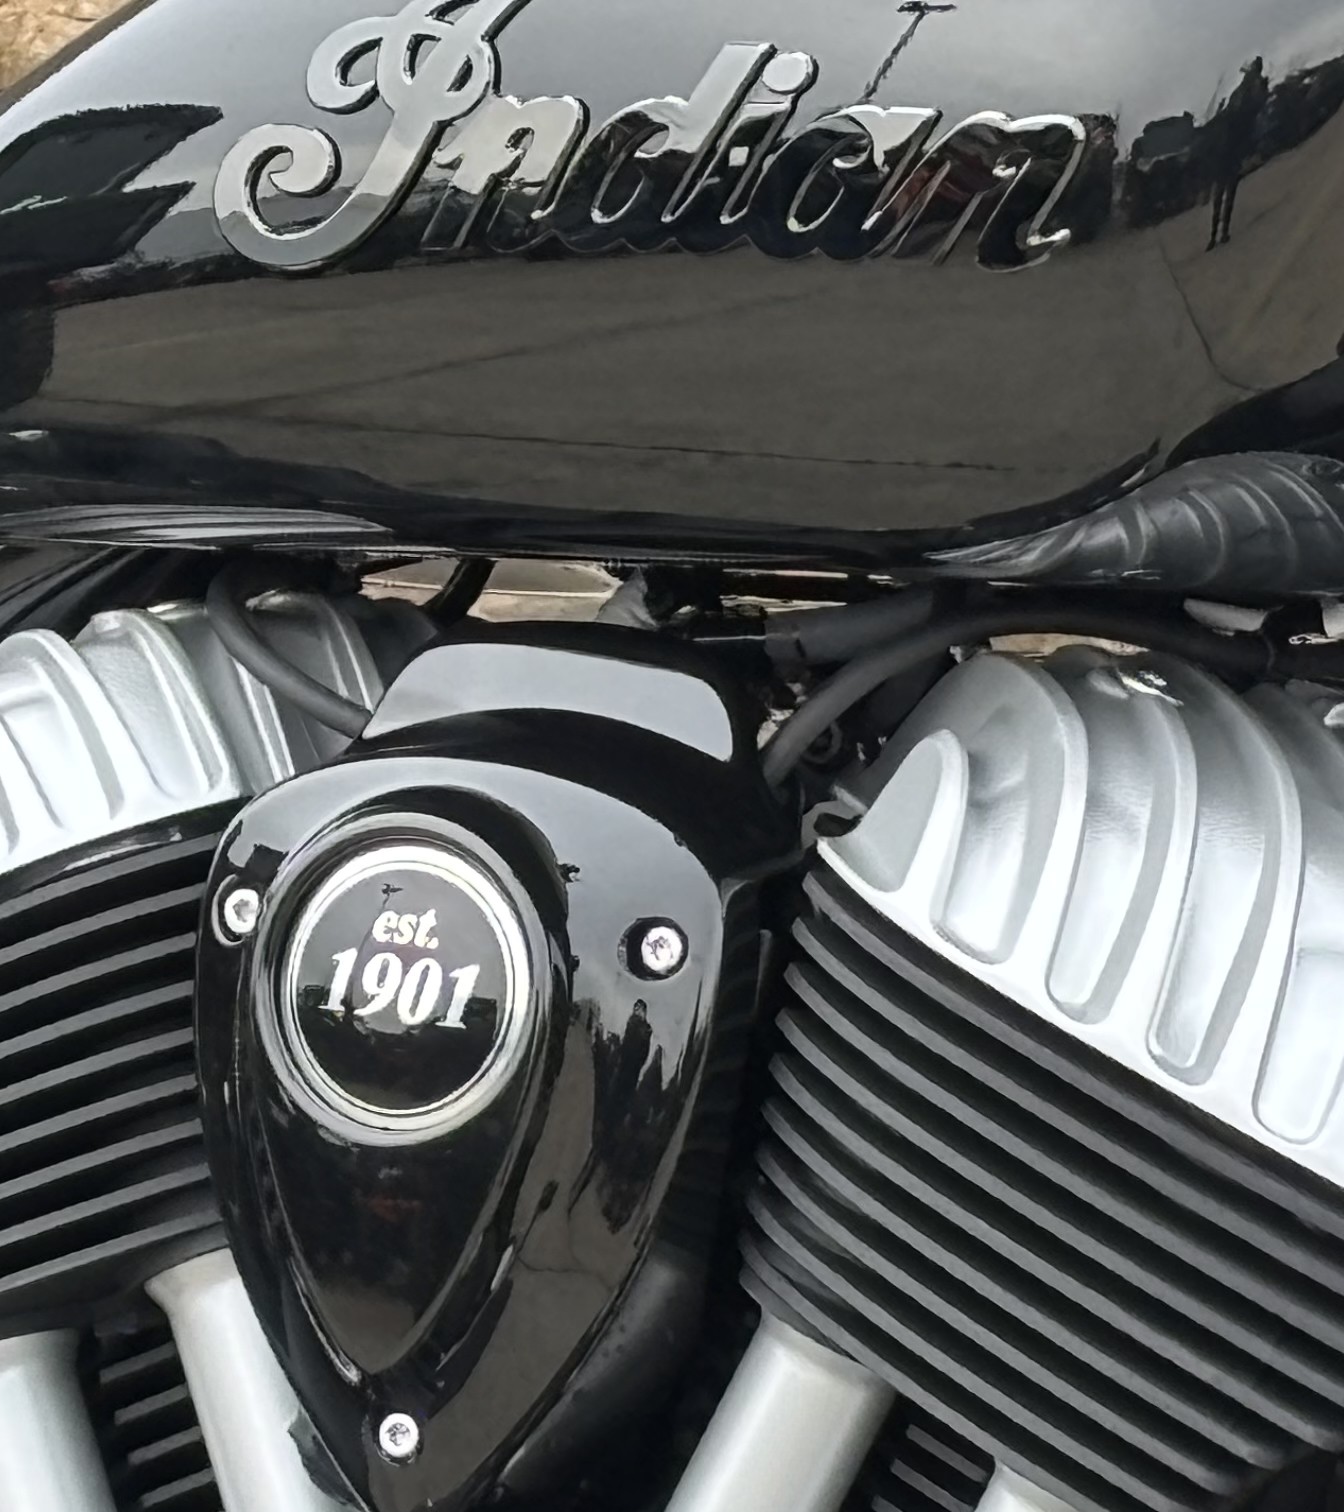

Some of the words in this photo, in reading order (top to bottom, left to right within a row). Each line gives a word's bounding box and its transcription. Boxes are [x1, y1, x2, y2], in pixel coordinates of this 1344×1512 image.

[214, 0, 1086, 271] Indian
[372, 908, 439, 949] est.
[318, 947, 480, 1029] 1901
